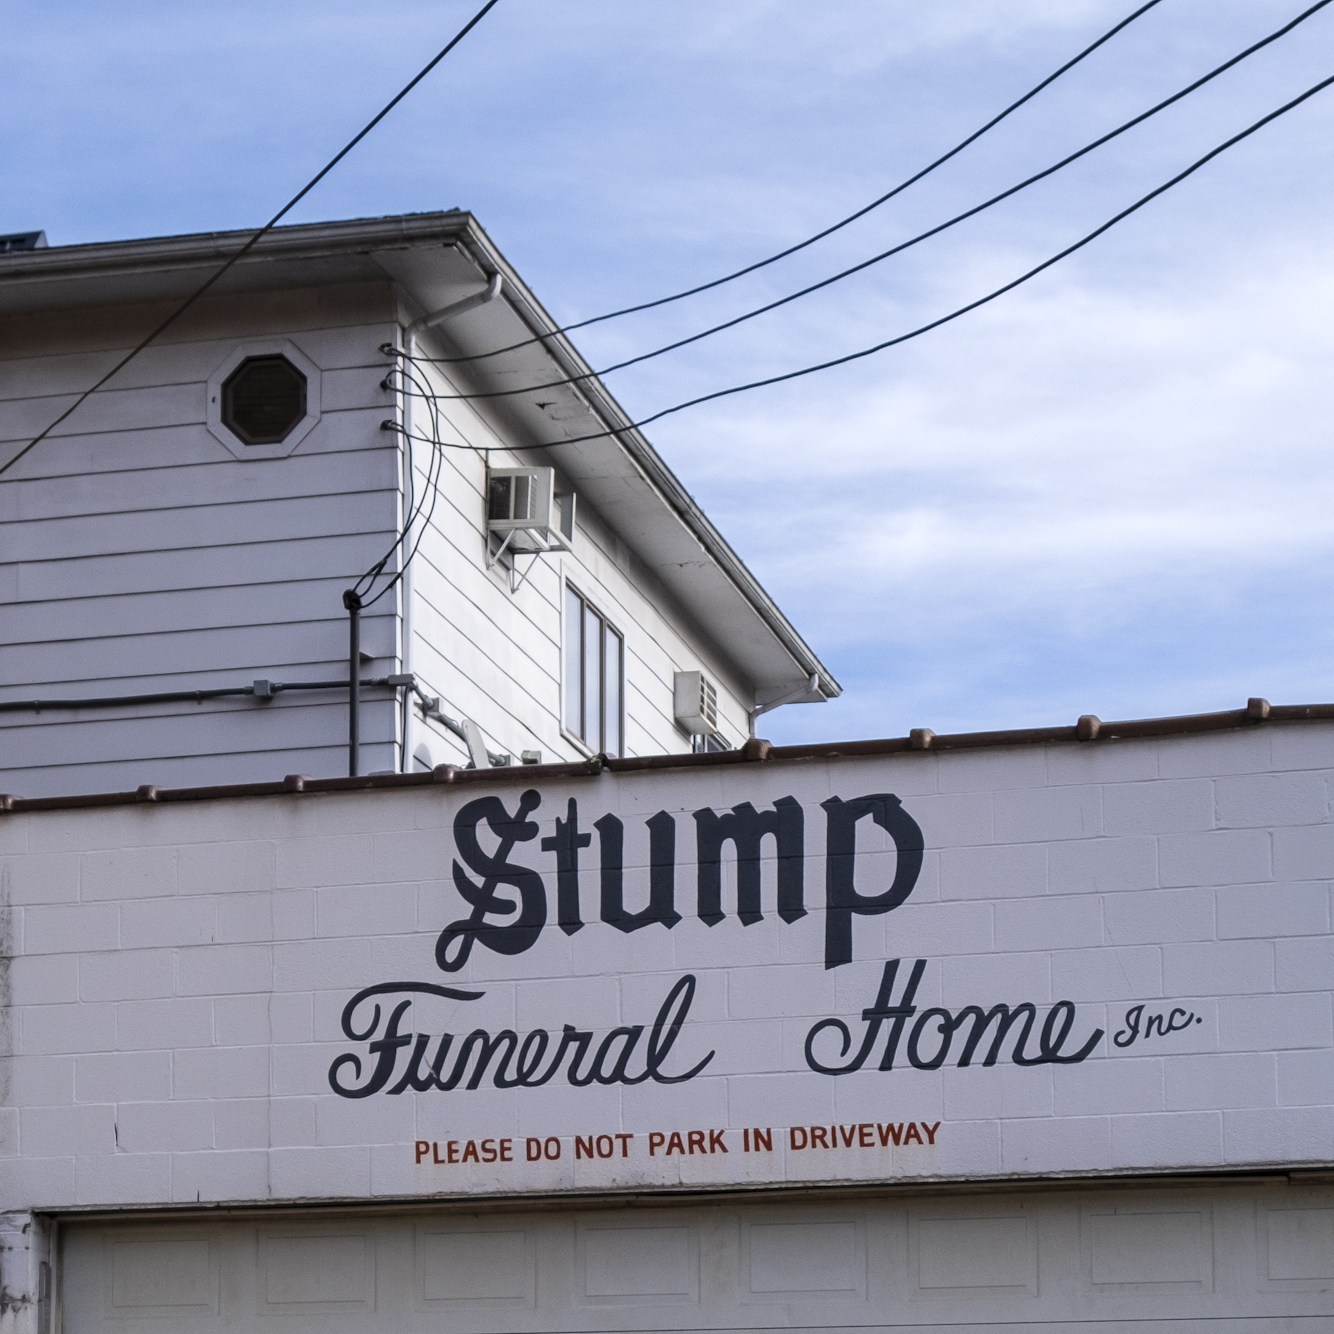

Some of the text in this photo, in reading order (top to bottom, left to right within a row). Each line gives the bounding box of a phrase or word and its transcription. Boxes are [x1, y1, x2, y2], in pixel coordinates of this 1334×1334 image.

[435, 789, 925, 972] Stump
[328, 957, 1204, 1099] Funeral Home Inc.
[415, 1121, 942, 1165] PLEASE DO NOT PARK IN DRIVEWAY
